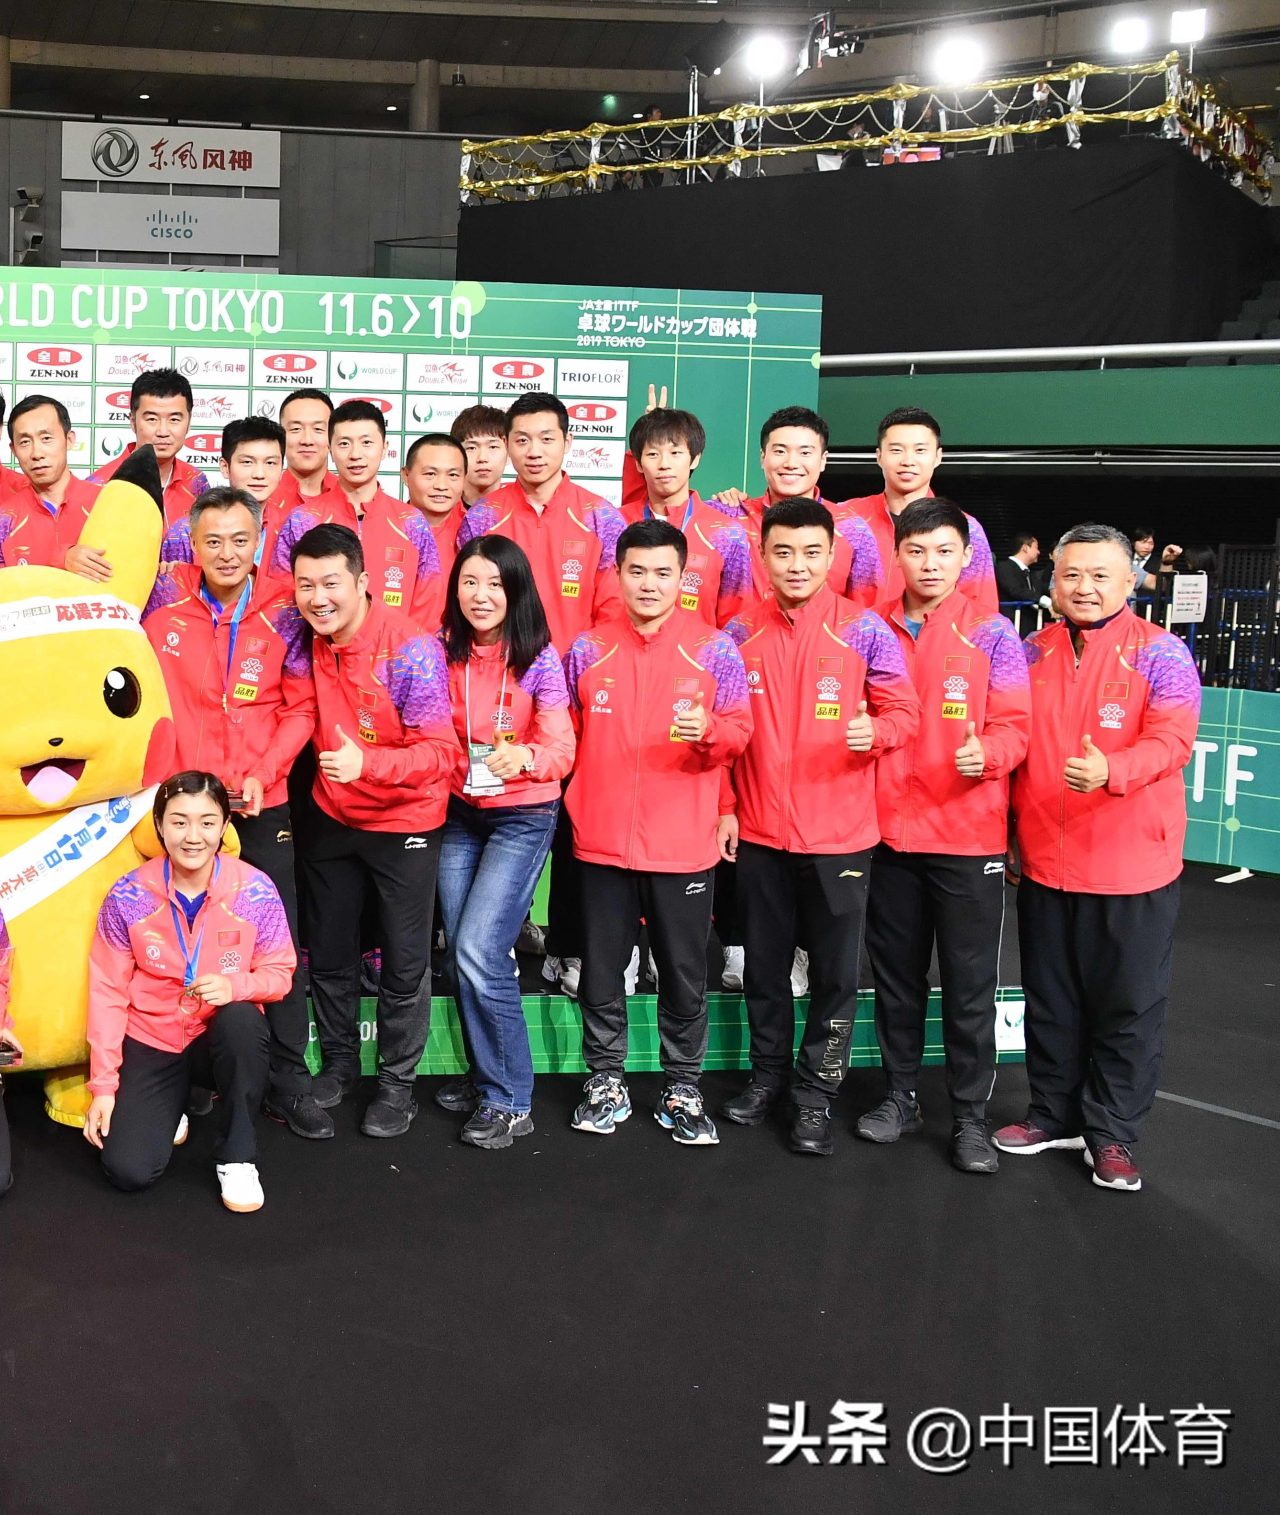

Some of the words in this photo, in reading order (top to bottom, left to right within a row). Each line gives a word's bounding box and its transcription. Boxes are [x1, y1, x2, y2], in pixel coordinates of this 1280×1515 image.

[148, 138, 252, 171] 东风风神
[150, 228, 193, 239] CISCO
[71, 284, 149, 330] CUP
[161, 286, 284, 334] TOKYO
[577, 313, 757, 338] 卓球ワールドカップ団体戦
[577, 335, 602, 347] 2019
[605, 336, 646, 348] TOKYO
[30, 369, 78, 378] ZEN-NOH
[561, 372, 621, 383] TRIOFLOR
[266, 375, 313, 384] ZEN-NOH
[495, 382, 541, 391] ZEN-NOH
[116, 394, 131, 406] 全
[193, 409, 212, 418] OUBLE
[568, 424, 614, 433] ZEN-NOH
[235, 687, 256, 697] 品胜
[817, 706, 838, 716] 品胜
[943, 705, 965, 716] 品胜
[1193, 740, 1258, 806] TF
